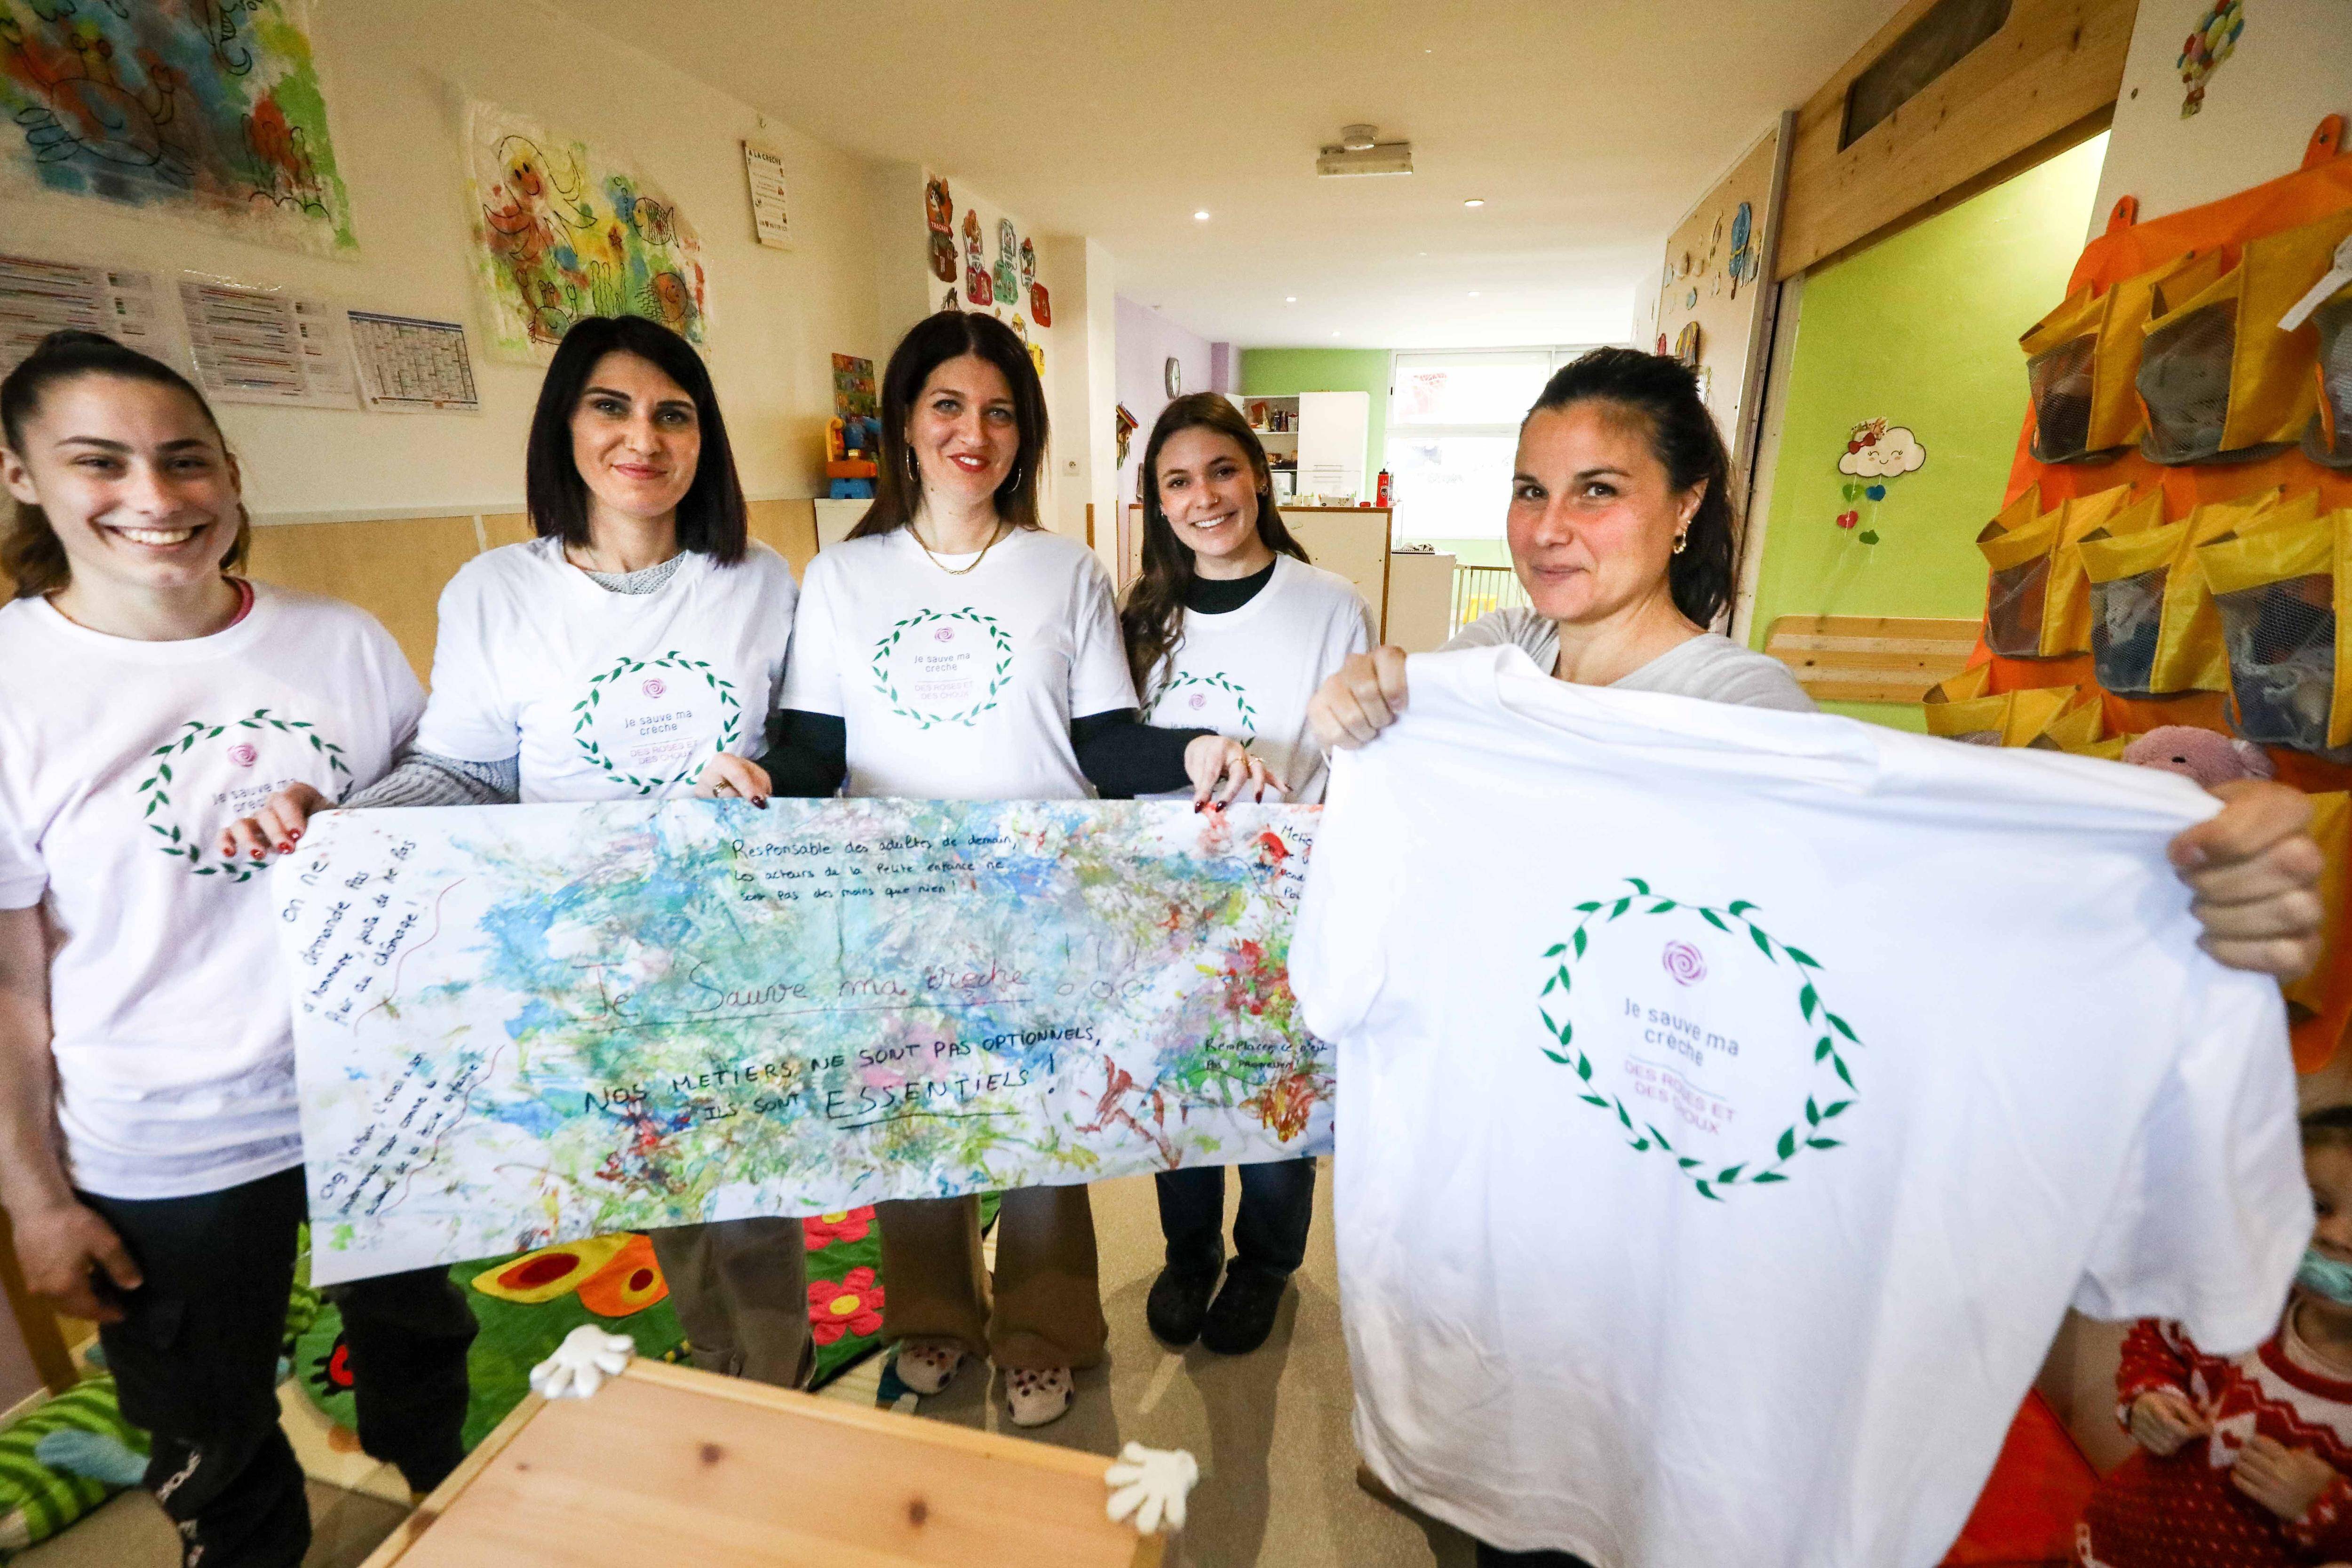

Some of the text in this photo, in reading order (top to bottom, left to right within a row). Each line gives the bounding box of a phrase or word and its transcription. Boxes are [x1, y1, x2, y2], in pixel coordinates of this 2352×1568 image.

[930, 221, 949, 233] TRACKER
[640, 713, 672, 725] sauve
[676, 710, 692, 719] ma
[630, 748, 650, 757] DES
[652, 743, 684, 753] ROSES
[639, 756, 658, 764] DES
[230, 783, 272, 799] sauve
[277, 778, 295, 790] m
[732, 838, 833, 860] Responsable
[844, 842, 868, 854] des
[942, 836, 957, 847] de
[301, 860, 330, 886] ne
[765, 869, 815, 879] acteurs
[825, 866, 840, 876] de
[849, 866, 862, 876] la
[927, 861, 976, 873] enfance
[986, 860, 1005, 869] ne
[813, 888, 833, 899] des
[841, 886, 874, 897] moins
[885, 886, 910, 899] que
[917, 884, 946, 894] rien
[838, 977, 907, 998] ma
[1648, 1008, 1701, 1041] sauve
[1706, 1032, 1740, 1057] ma
[1645, 1027, 1703, 1067] crèche
[585, 1027, 1101, 1113] NOS METIERS NE SONT PAS OPTIONNELS,
[704, 1103, 738, 1121] ILS
[754, 1093, 801, 1114] SONT
[826, 1069, 1030, 1119] ESSENTIELS
[1625, 1059, 1657, 1082] DES
[1712, 1103, 1735, 1121] ET
[1635, 1081, 1669, 1103] DES
